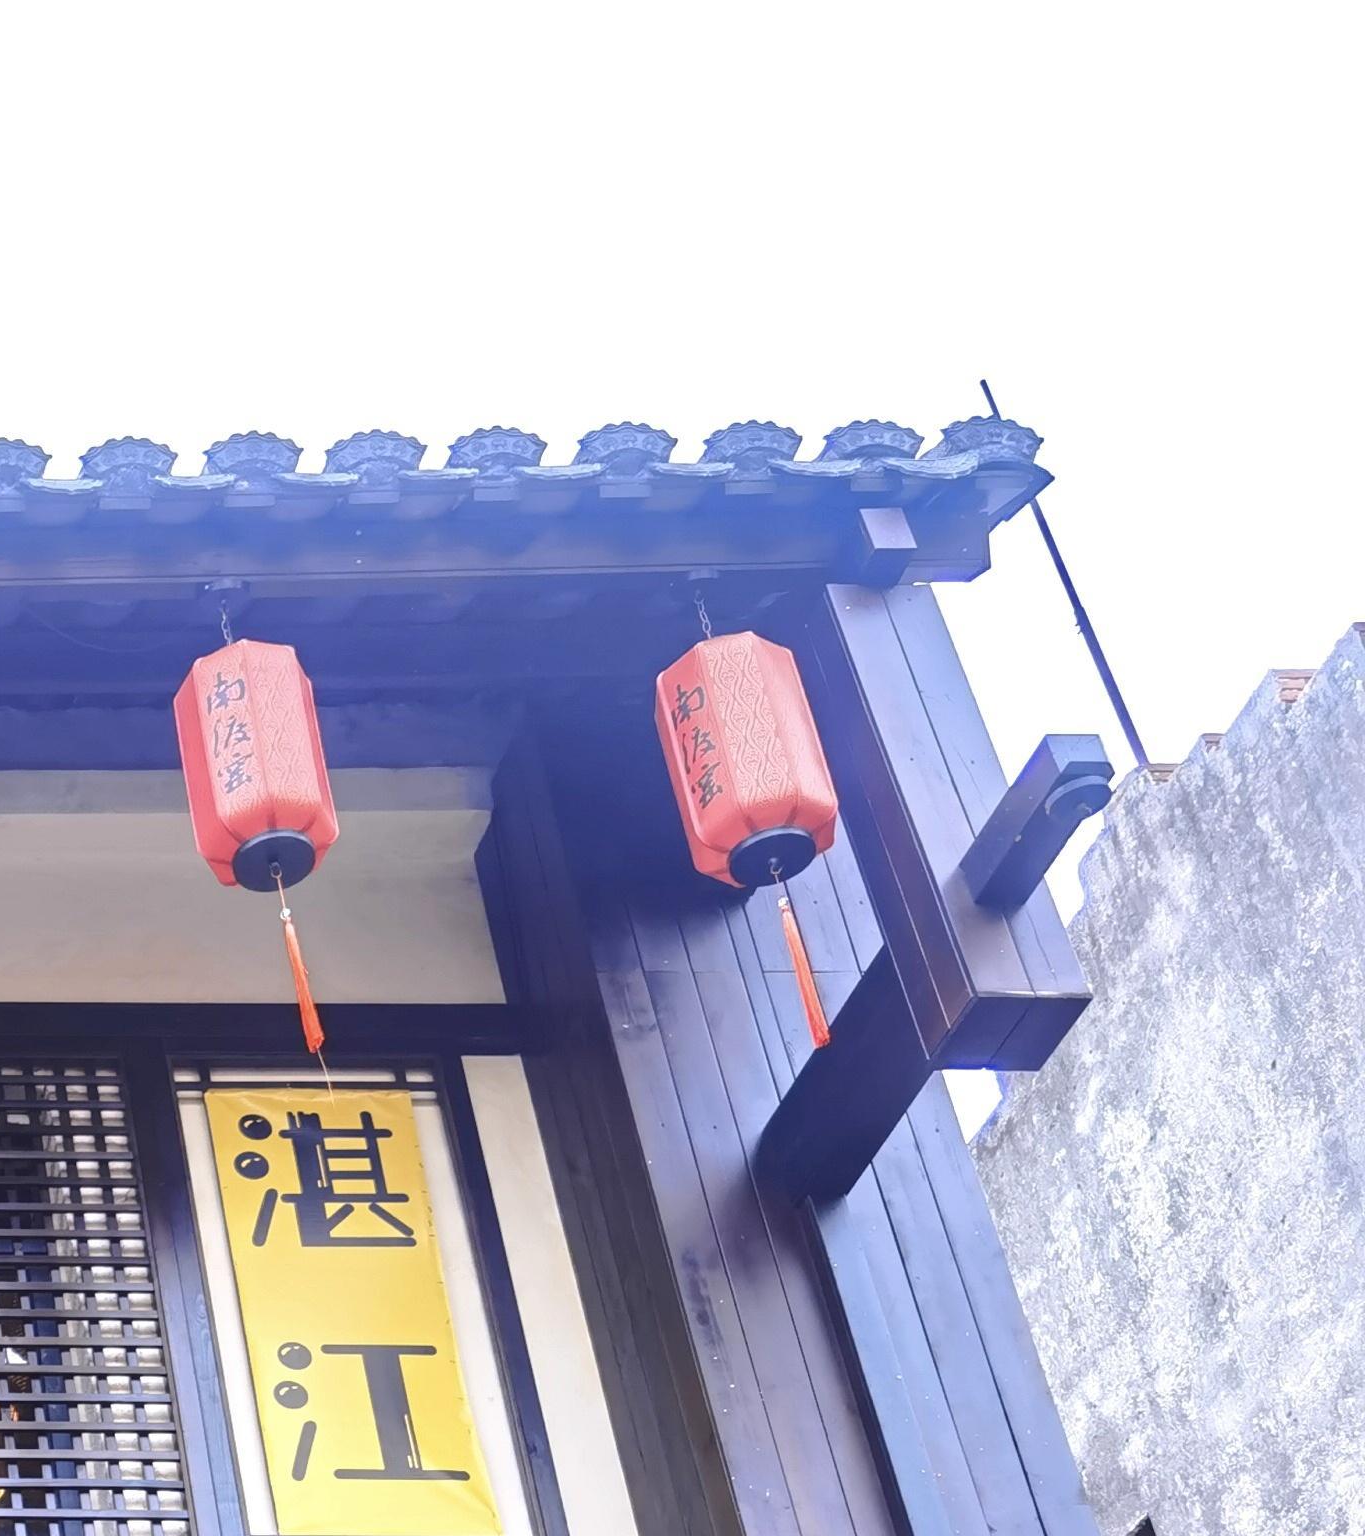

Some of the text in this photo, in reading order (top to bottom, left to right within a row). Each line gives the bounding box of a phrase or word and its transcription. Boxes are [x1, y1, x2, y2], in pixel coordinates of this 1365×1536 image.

[207, 671, 254, 795] 南渡窑
[671, 683, 723, 810] 南渡窑
[232, 1109, 471, 1483] 湛江
